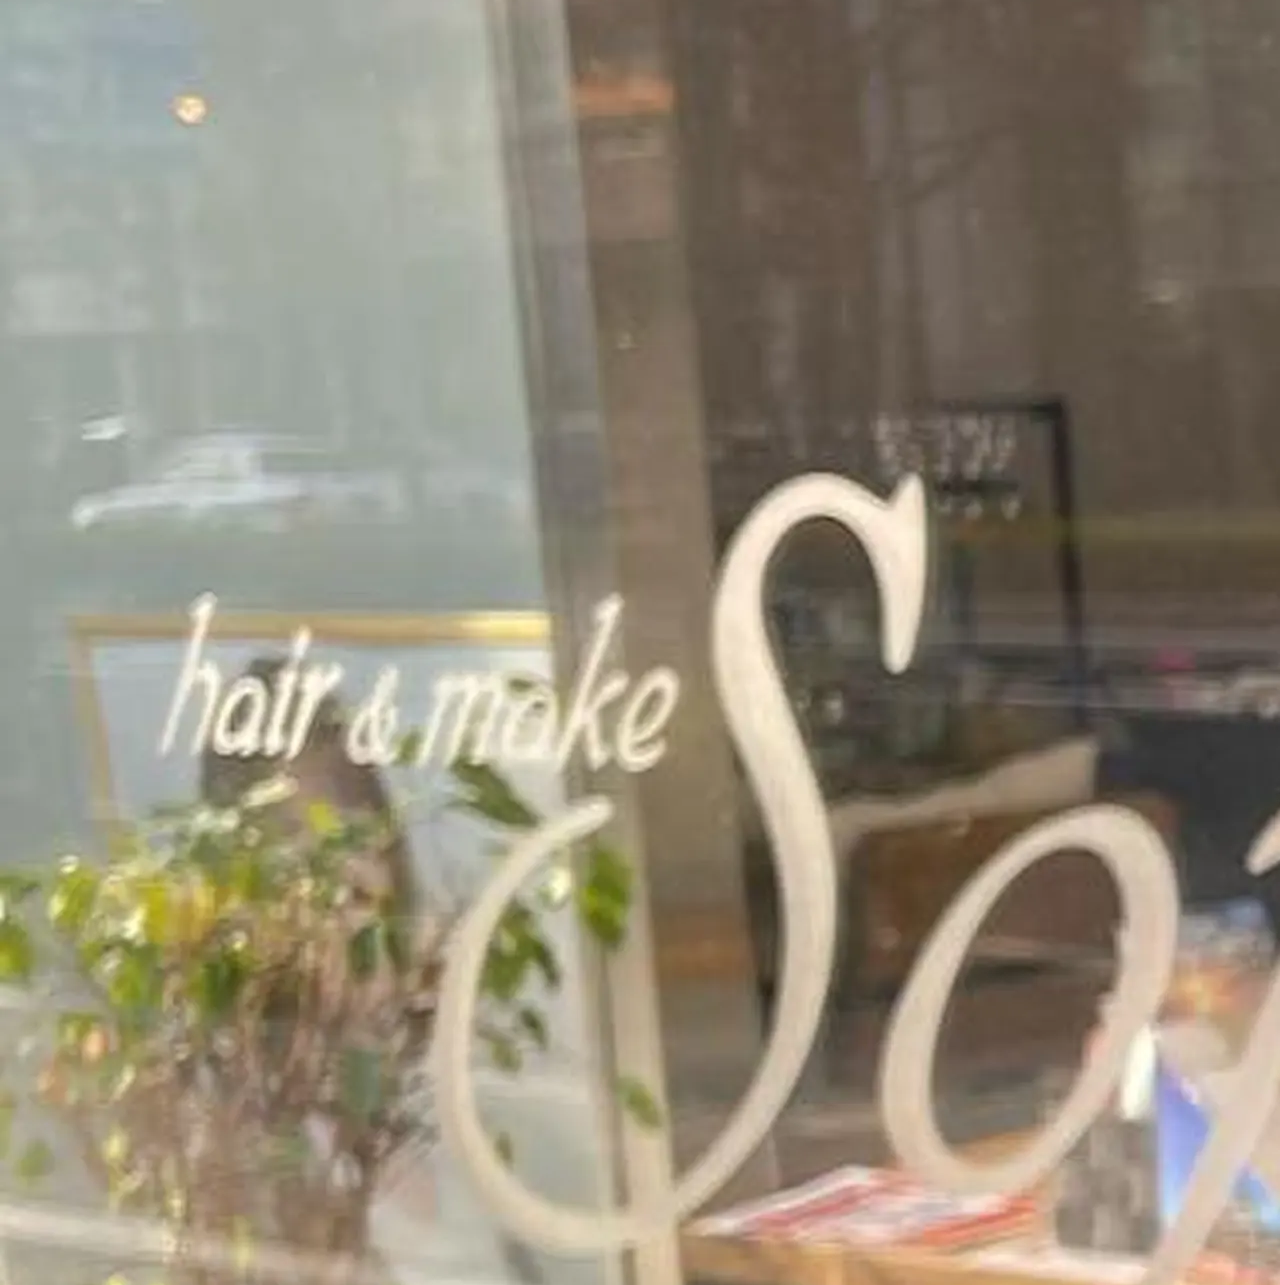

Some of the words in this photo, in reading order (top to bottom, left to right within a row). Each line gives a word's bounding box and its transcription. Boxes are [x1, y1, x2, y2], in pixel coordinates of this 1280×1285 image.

[160, 590, 344, 758] hair
[346, 664, 400, 767] &
[416, 591, 681, 773] make
